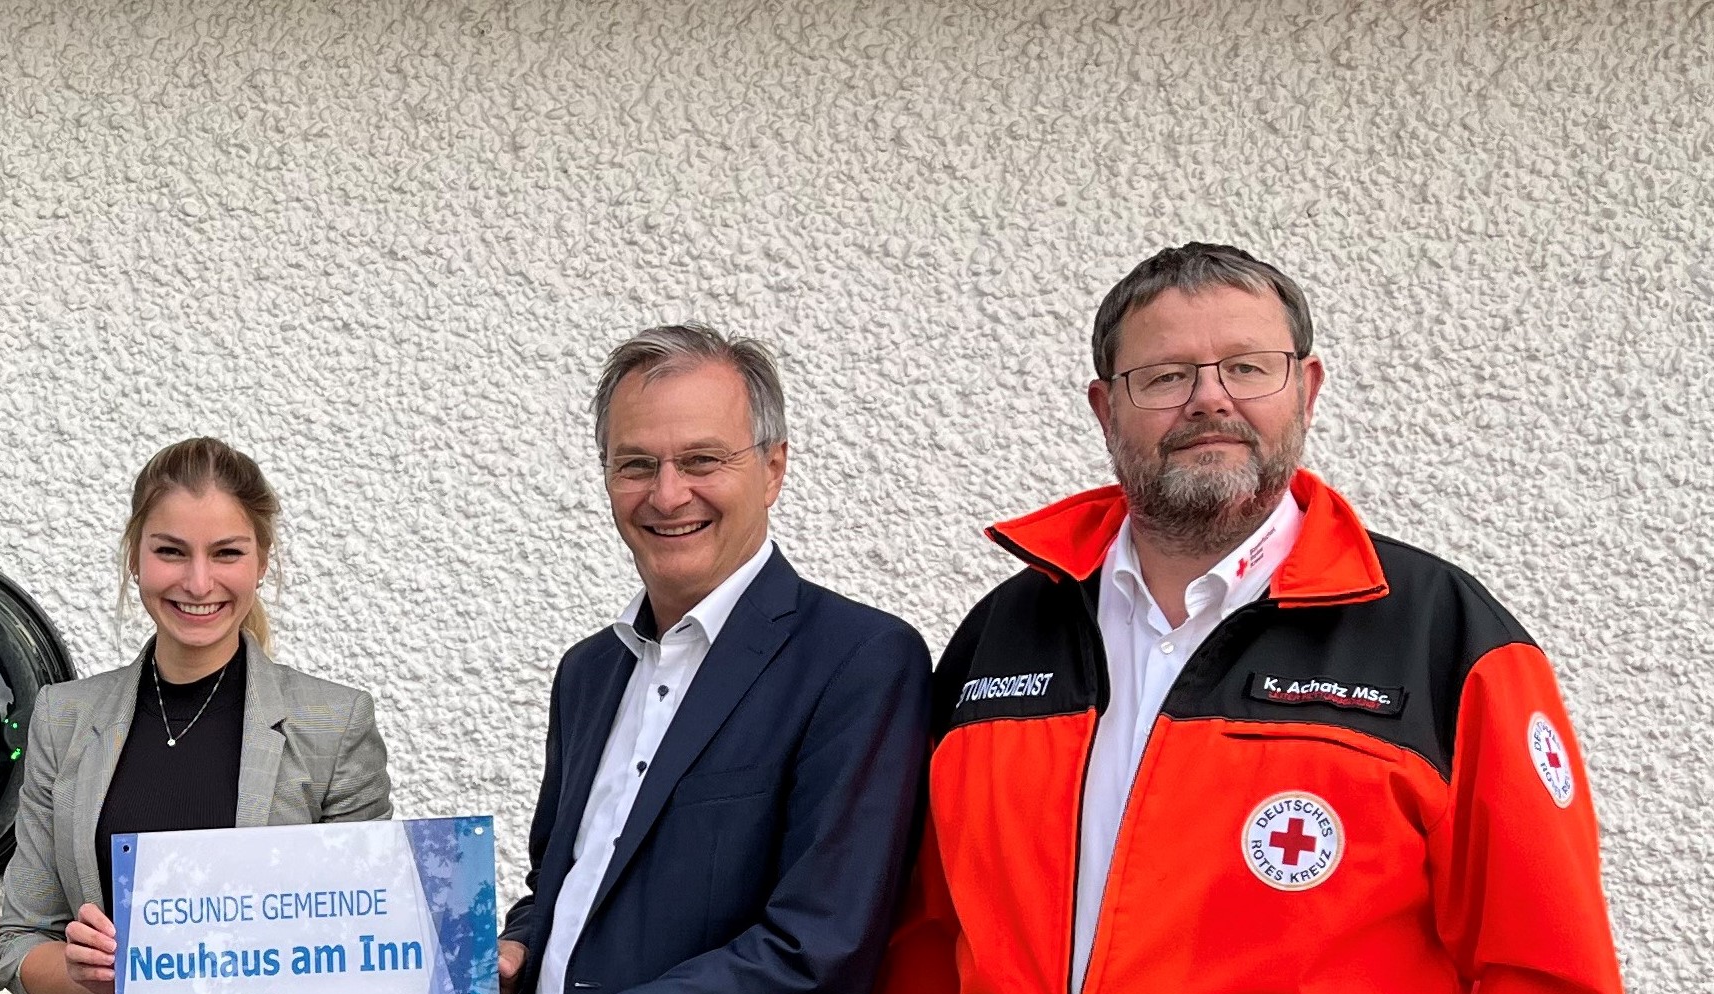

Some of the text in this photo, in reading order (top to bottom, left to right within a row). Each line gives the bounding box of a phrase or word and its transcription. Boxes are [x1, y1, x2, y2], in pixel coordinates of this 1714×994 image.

[1264, 677, 1281, 692] K.
[1287, 680, 1347, 698] Achatz
[1352, 686, 1391, 704] MSc.
[1256, 799, 1333, 837] DEUTSCHES
[1251, 839, 1331, 883] ROTES KREUZ
[143, 888, 388, 925] GESUNDE GEMEINDE
[130, 934, 423, 982] Neuhaus am Inn
